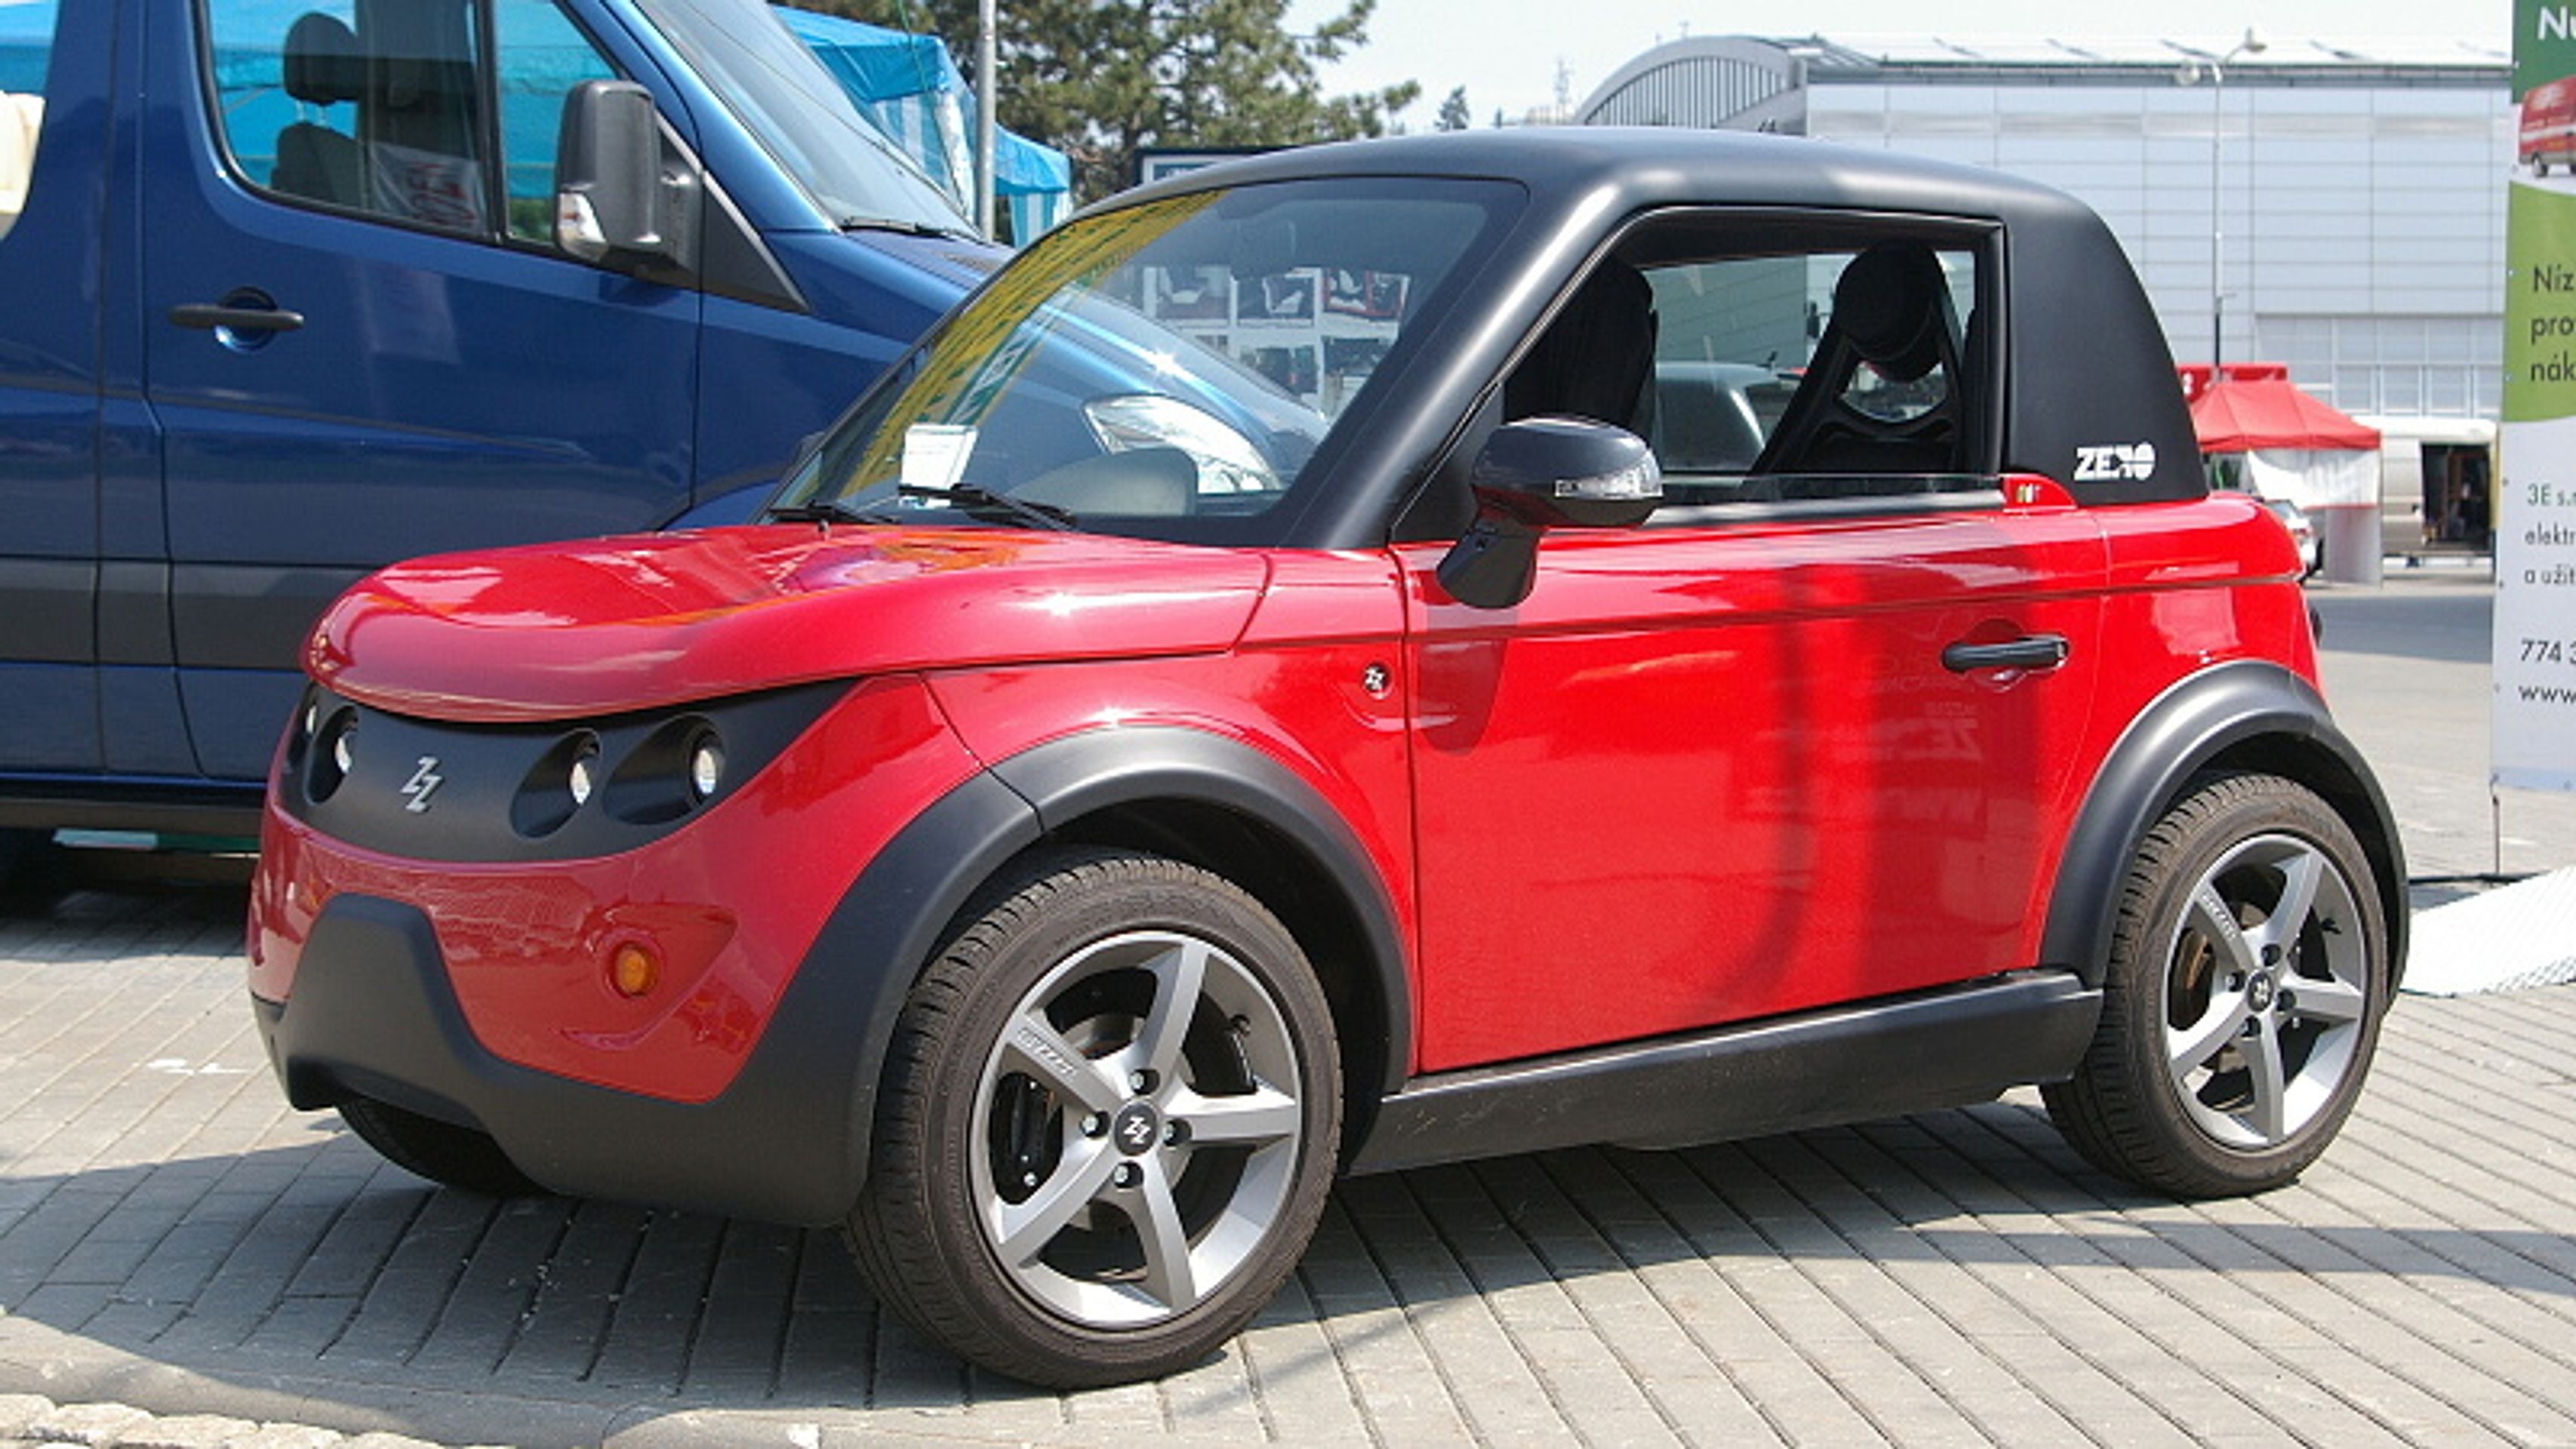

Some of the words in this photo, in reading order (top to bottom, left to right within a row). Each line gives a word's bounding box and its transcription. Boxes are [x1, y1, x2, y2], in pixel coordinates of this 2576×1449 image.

[2073, 441, 2156, 481] ZERO
[2528, 483, 2551, 506] 3E
[2521, 638, 2561, 662] 774
